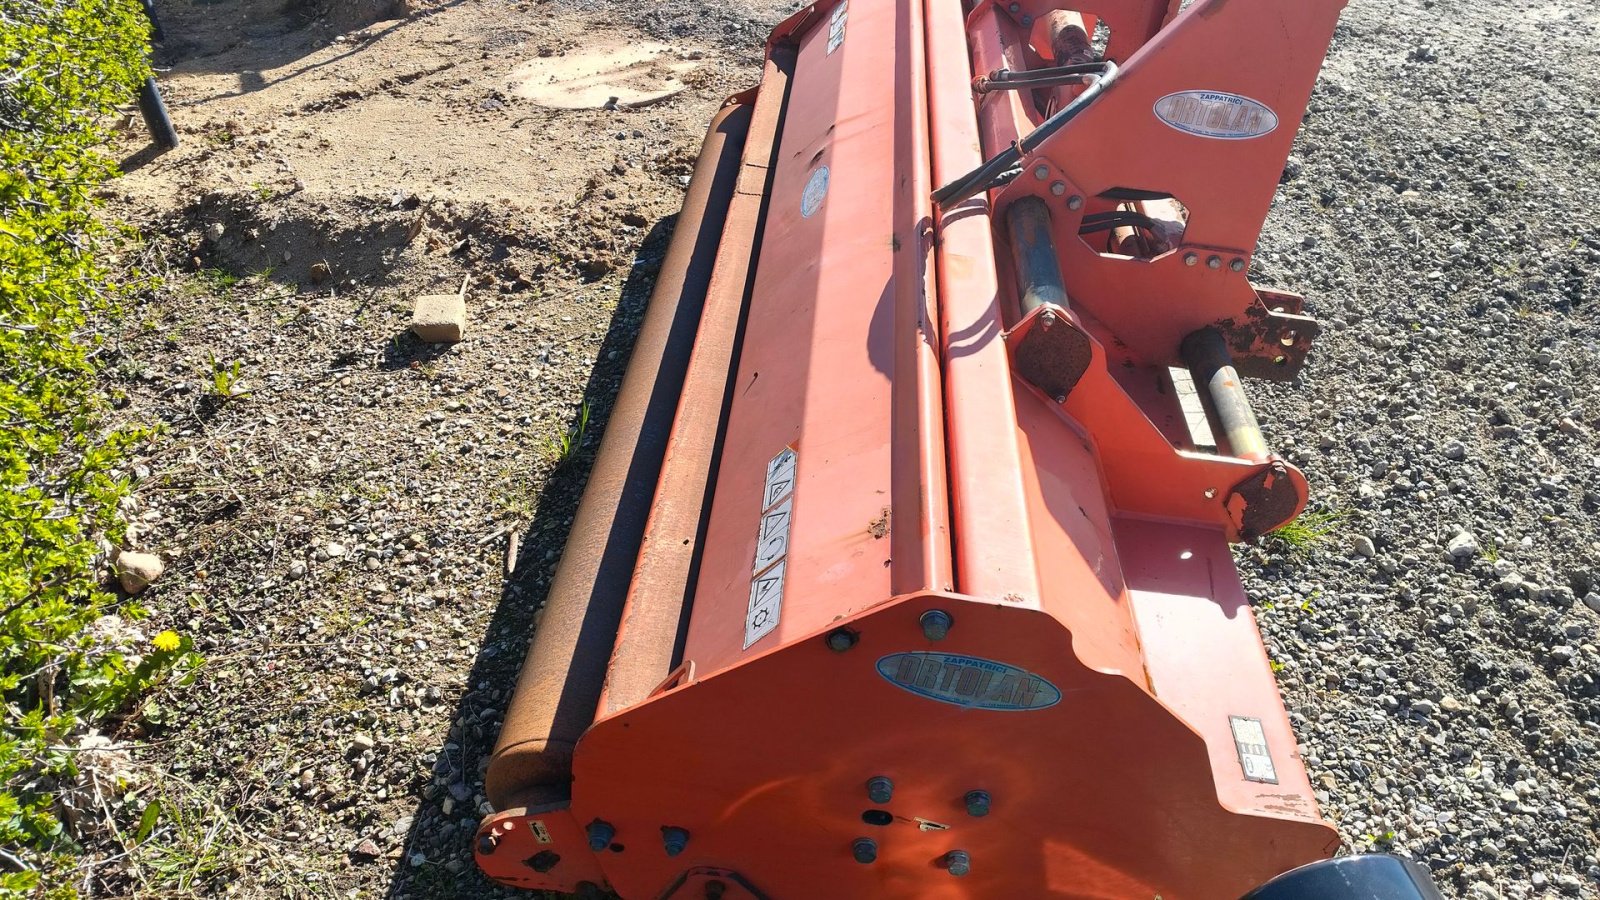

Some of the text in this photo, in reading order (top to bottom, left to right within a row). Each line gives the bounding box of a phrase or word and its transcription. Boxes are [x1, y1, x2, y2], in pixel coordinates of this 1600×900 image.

[1200, 94, 1243, 105] ZAPPATRICI
[1166, 95, 1264, 133] ORTOLAN
[943, 656, 1008, 674] ZAPPATRICI
[895, 655, 1042, 706] ORTOLAN
